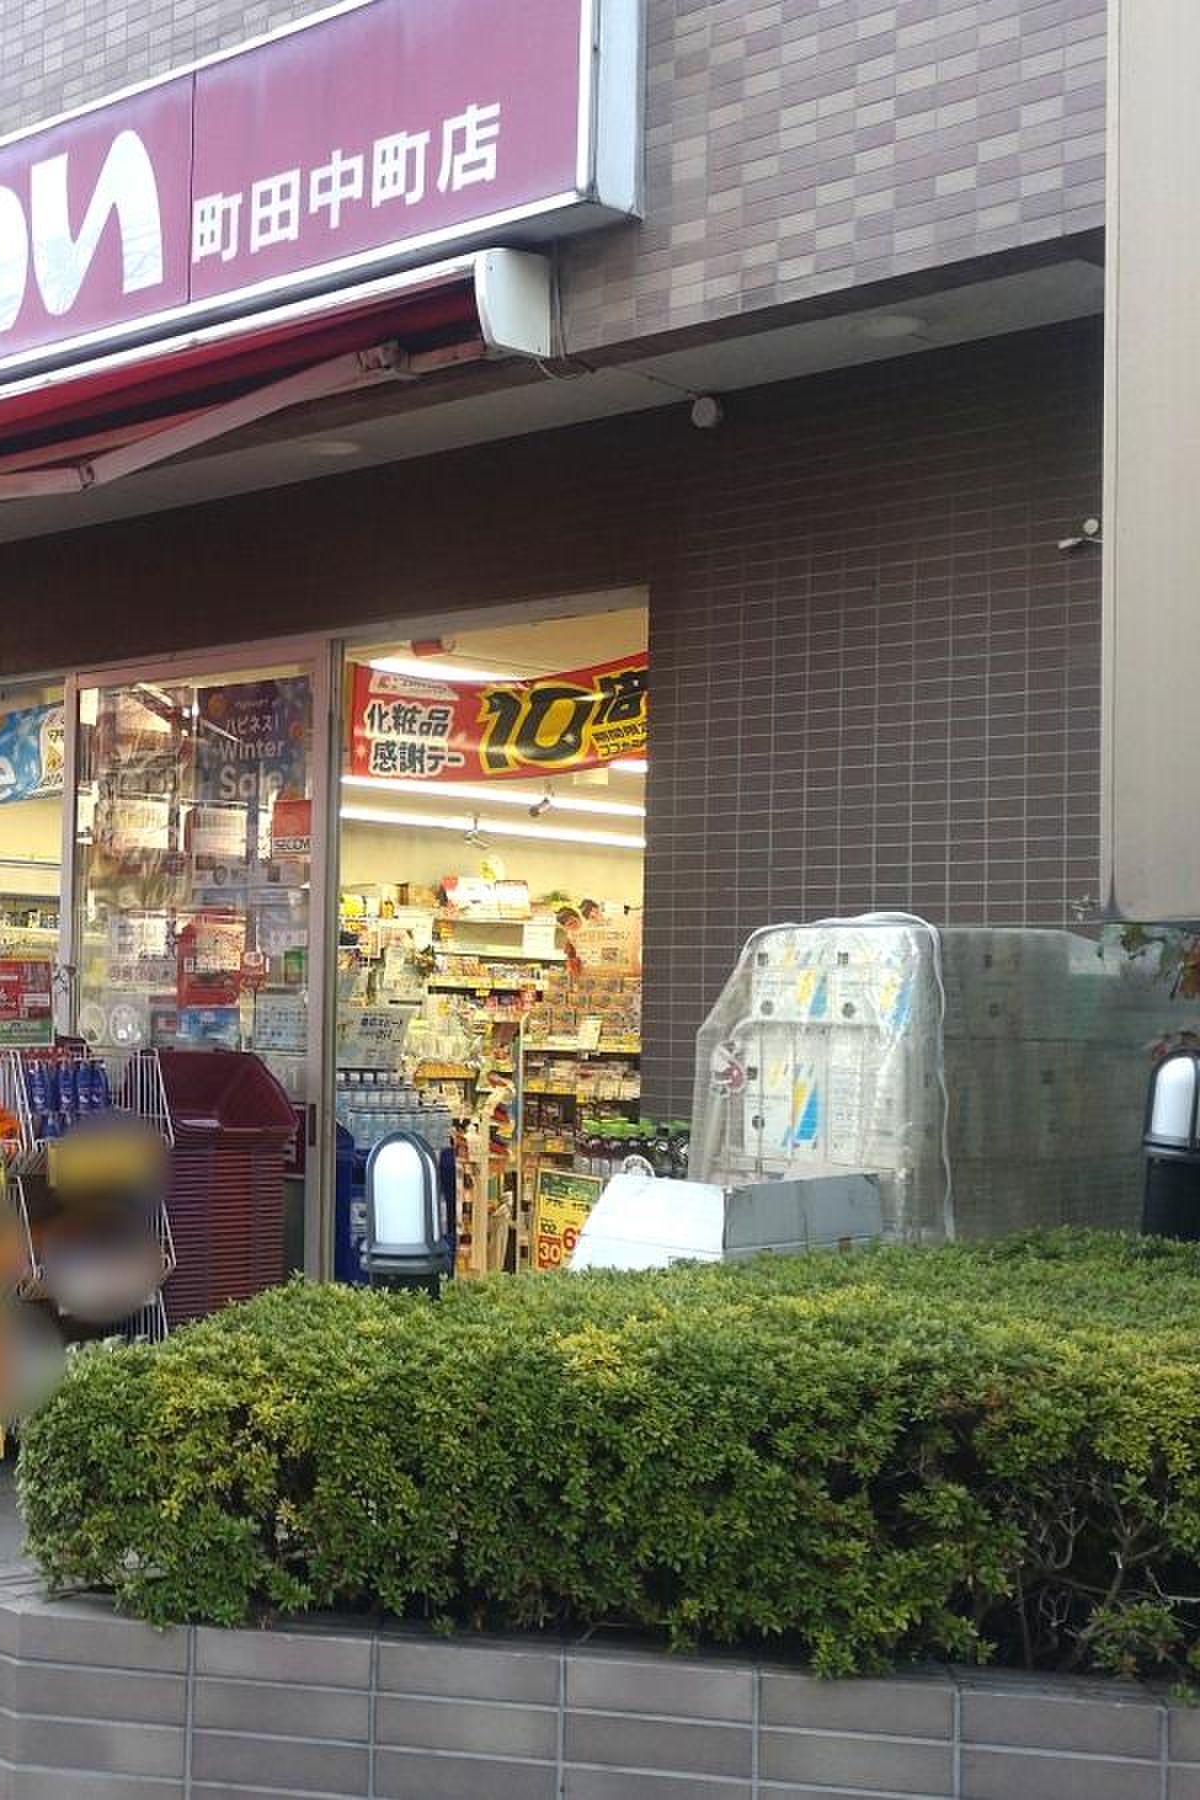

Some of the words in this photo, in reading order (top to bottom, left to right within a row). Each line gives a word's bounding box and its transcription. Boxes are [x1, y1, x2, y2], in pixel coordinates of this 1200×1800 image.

[191, 102, 500, 263] 町田中町店
[367, 703, 451, 737] 化粧品
[372, 740, 462, 773] 感謝デー
[539, 1242, 560, 1263] 30
